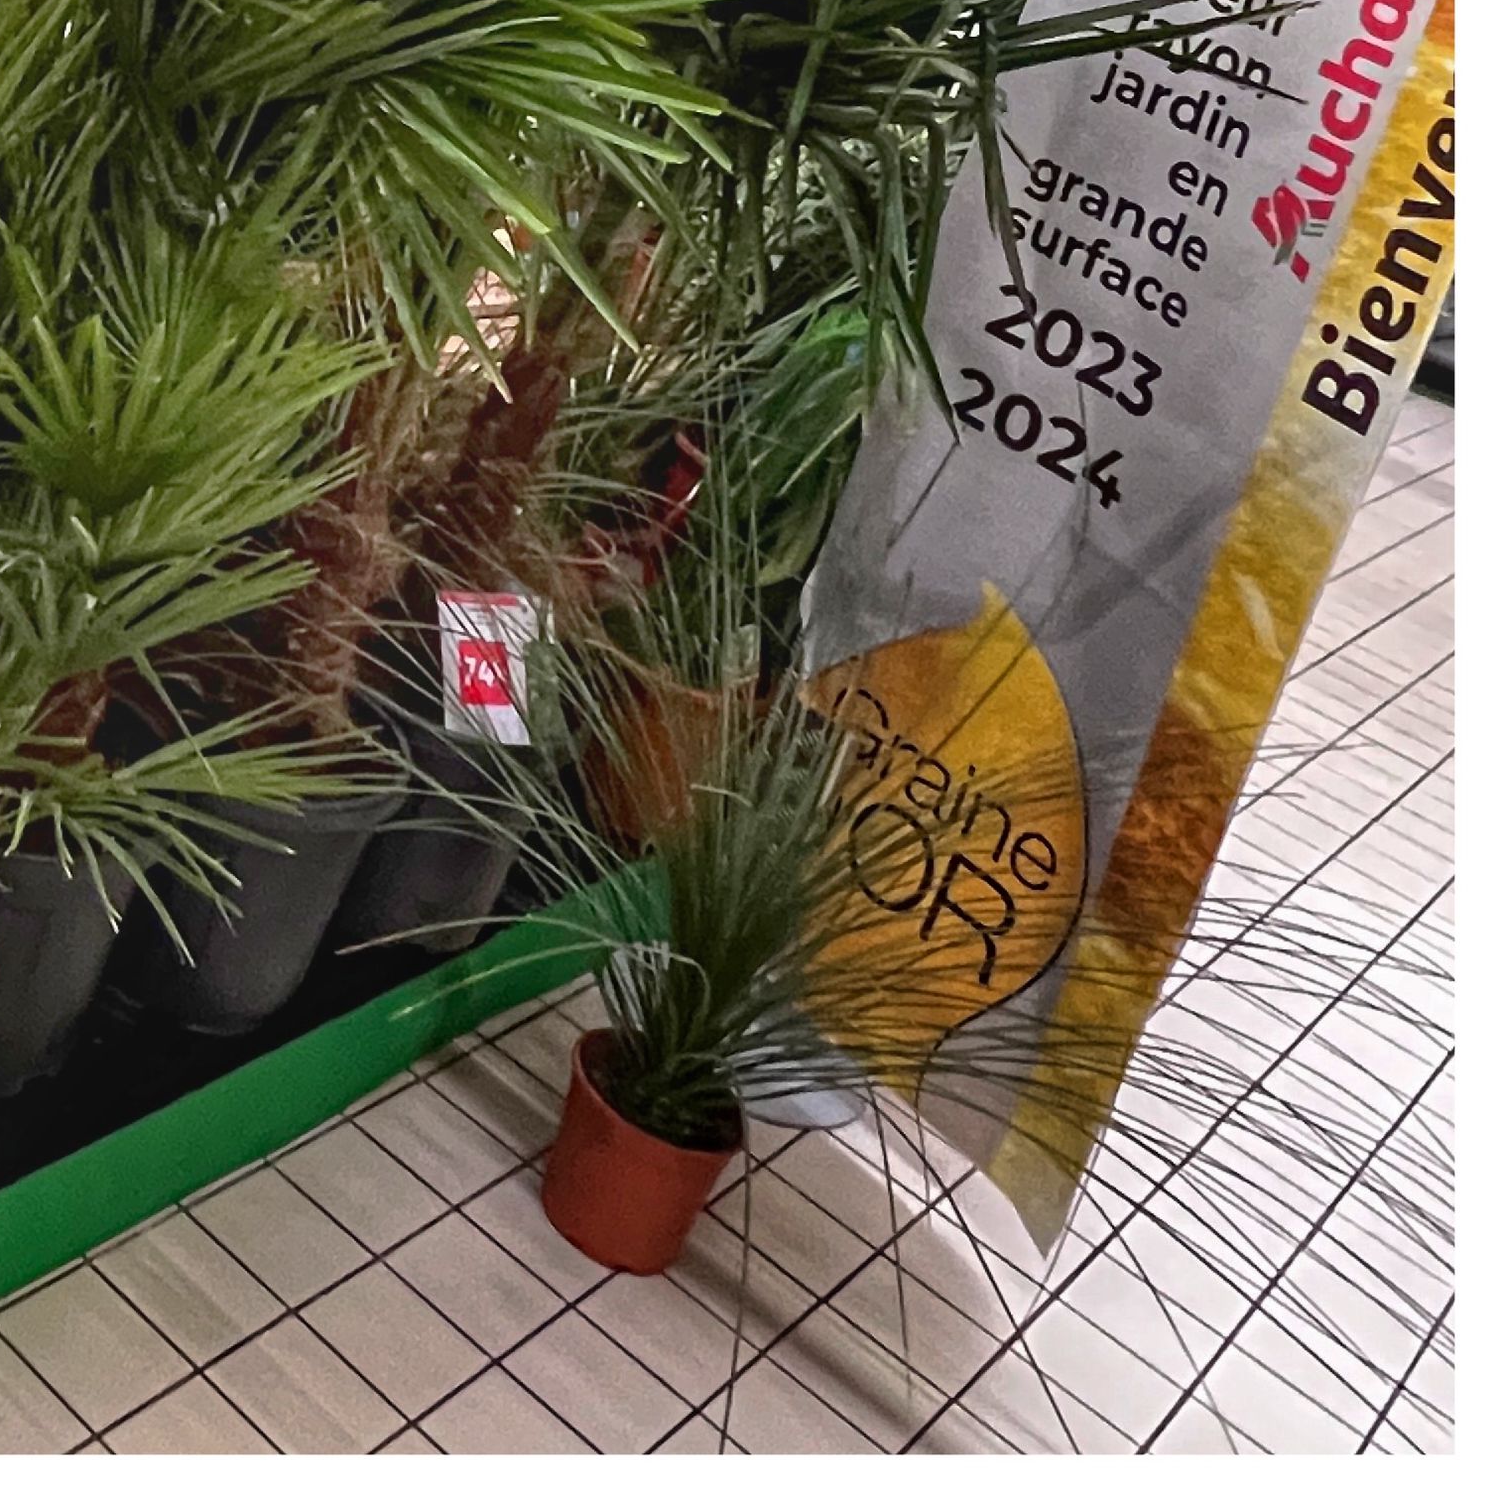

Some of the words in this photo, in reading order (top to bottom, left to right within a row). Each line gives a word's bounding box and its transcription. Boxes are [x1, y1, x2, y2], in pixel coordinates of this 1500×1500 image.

[1090, 51, 1250, 159] jardin
[1024, 158, 1208, 272] grande
[1168, 160, 1228, 217] en
[1009, 206, 1188, 328] surface
[984, 284, 1162, 417] 2023
[953, 367, 1123, 510] 2024
